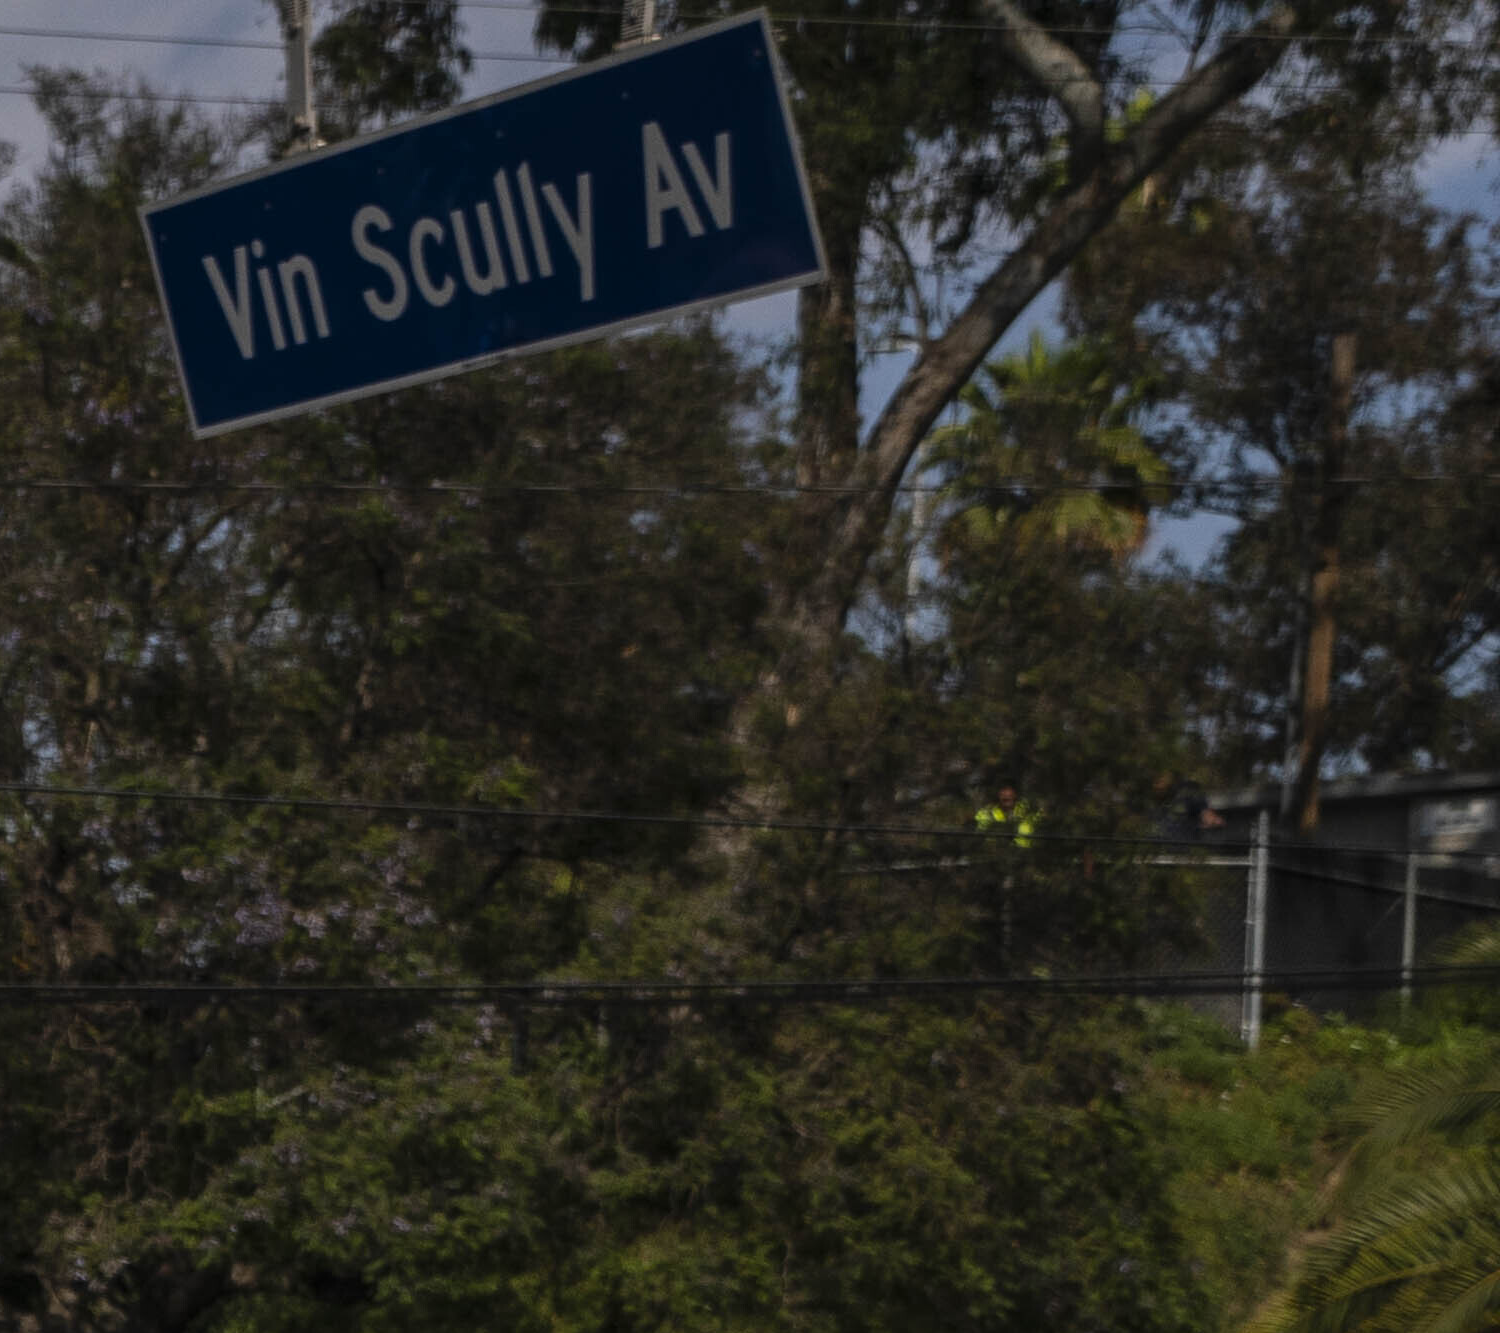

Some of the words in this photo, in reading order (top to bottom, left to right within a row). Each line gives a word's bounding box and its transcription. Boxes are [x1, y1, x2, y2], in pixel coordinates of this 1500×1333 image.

[201, 239, 331, 361] Vin
[350, 161, 596, 323] Scully
[640, 121, 733, 251] Av
